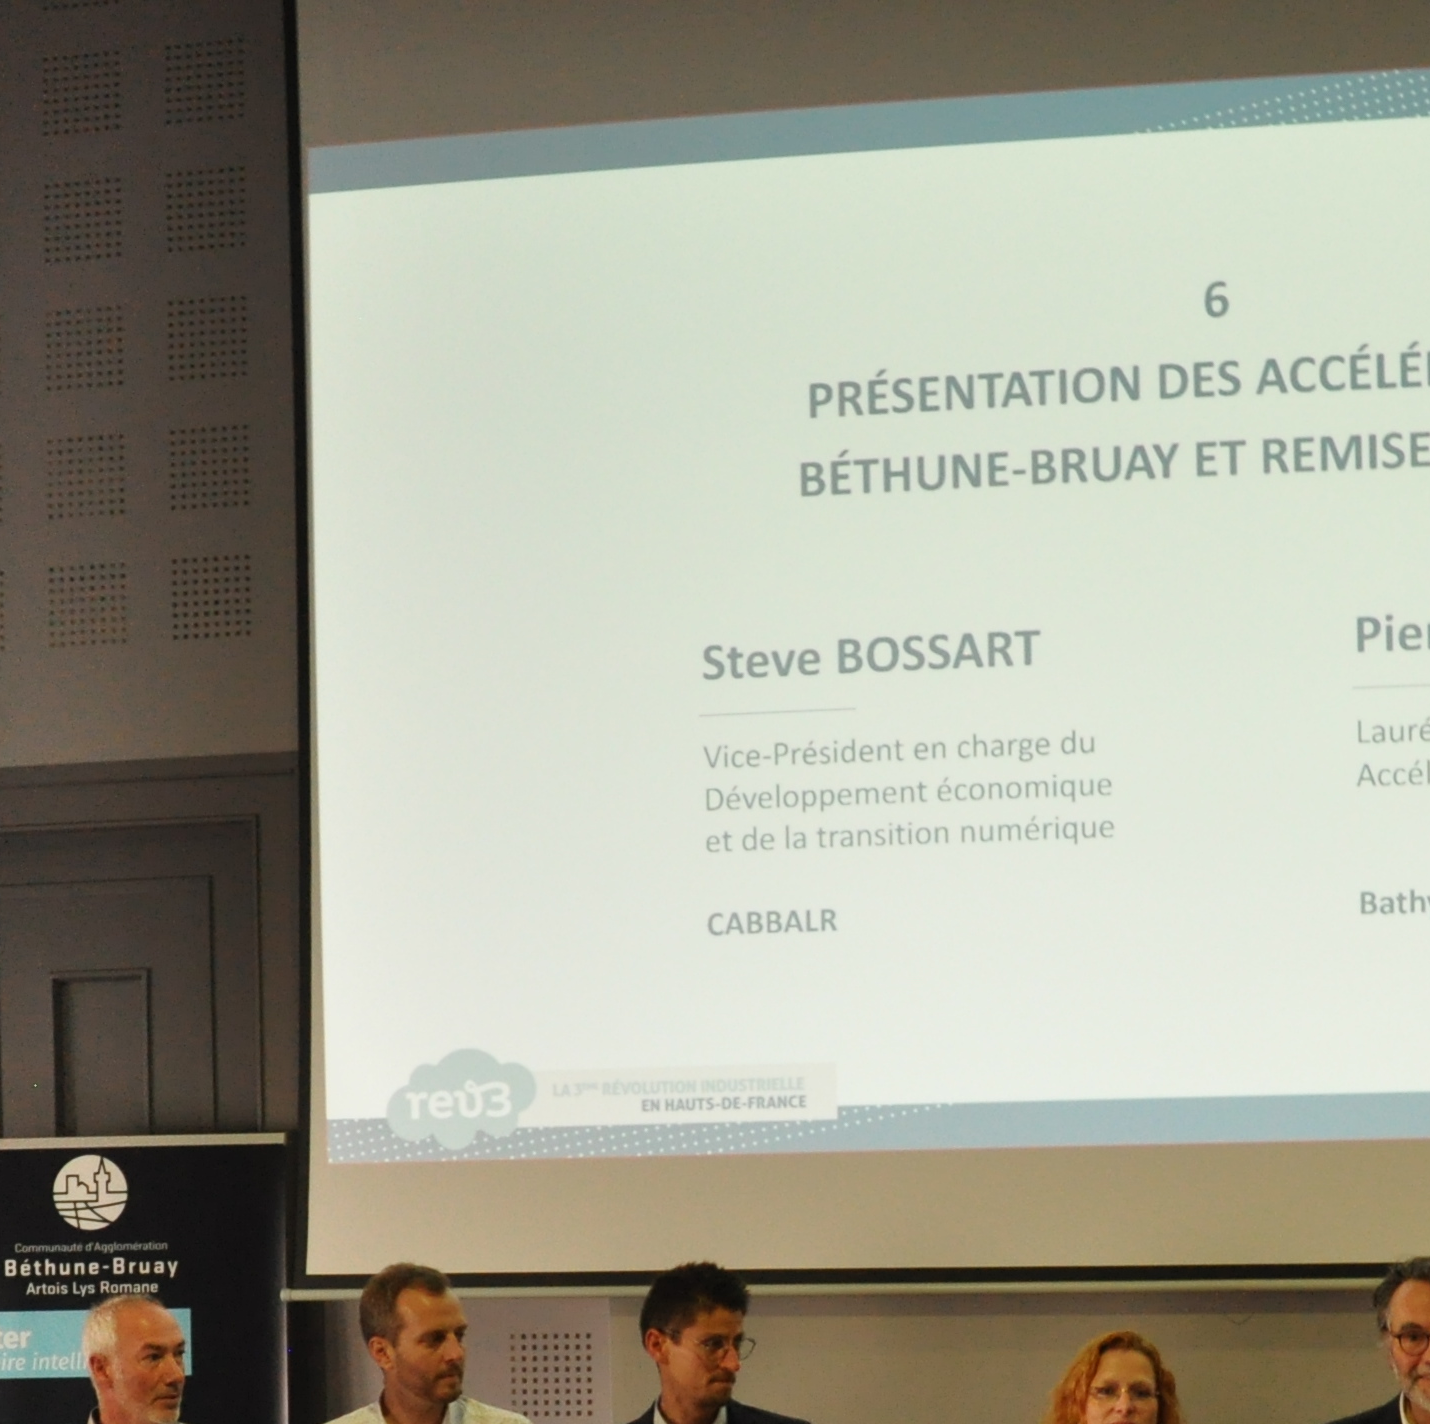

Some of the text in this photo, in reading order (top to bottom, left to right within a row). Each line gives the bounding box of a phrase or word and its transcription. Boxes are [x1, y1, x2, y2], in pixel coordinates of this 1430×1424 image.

[1202, 280, 1231, 320] 6
[805, 360, 1142, 420] PRÉSENTATION
[1156, 356, 1242, 404] DES
[798, 438, 1180, 499] BÉTHUNE-BRUAY
[1193, 433, 1247, 479] ET
[701, 629, 1042, 681] Steve BOSSART
[702, 729, 1097, 769] Vice-Président en charge du
[705, 773, 1114, 814] Développement économique
[705, 815, 1116, 853] et de la transition numérique
[706, 908, 839, 936] CABBALR
[552, 1083, 572, 1098] LA
[601, 1078, 697, 1098] RÉVOLUTION
[700, 1076, 806, 1096] INDUSTRIELLE
[640, 1095, 808, 1113] EN HAUTS-DE-FRANCE
[14, 1240, 169, 1254] Communauté d'Agglomération
[3, 1256, 179, 1279] Béthune-Bruay
[25, 1280, 160, 1298] Artois Lys Romane
